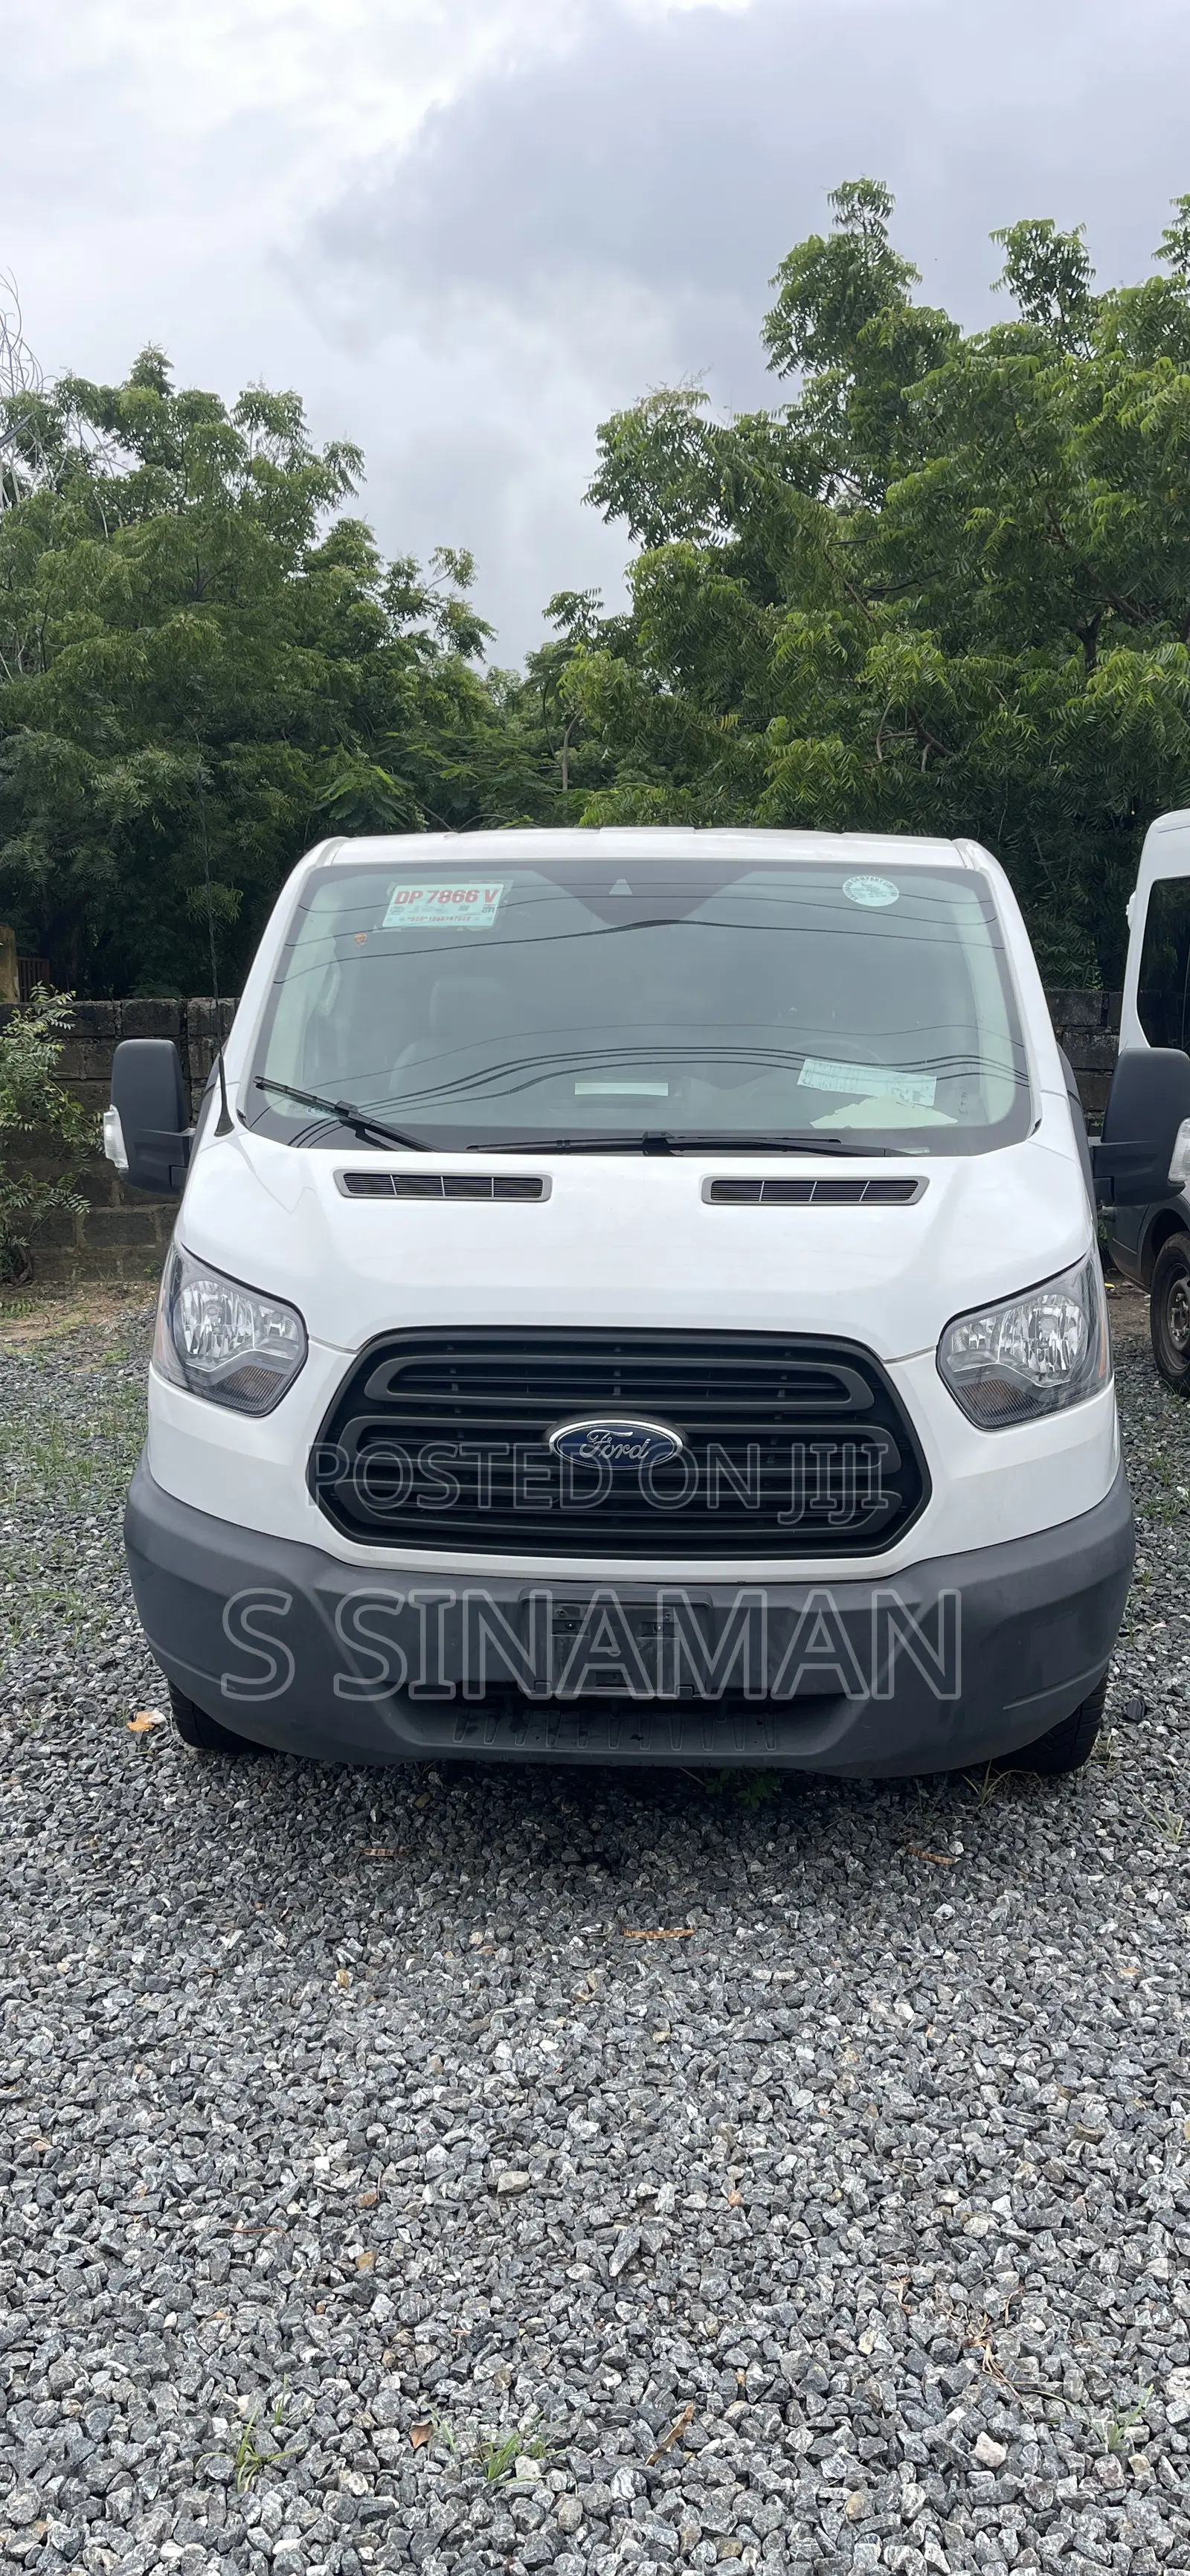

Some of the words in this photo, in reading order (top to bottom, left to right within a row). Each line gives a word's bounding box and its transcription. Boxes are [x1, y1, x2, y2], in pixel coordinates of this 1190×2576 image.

[394, 890, 423, 905] DP
[426, 889, 480, 904] 7866
[484, 889, 499, 903] V
[579, 1429, 652, 1459] Ford
